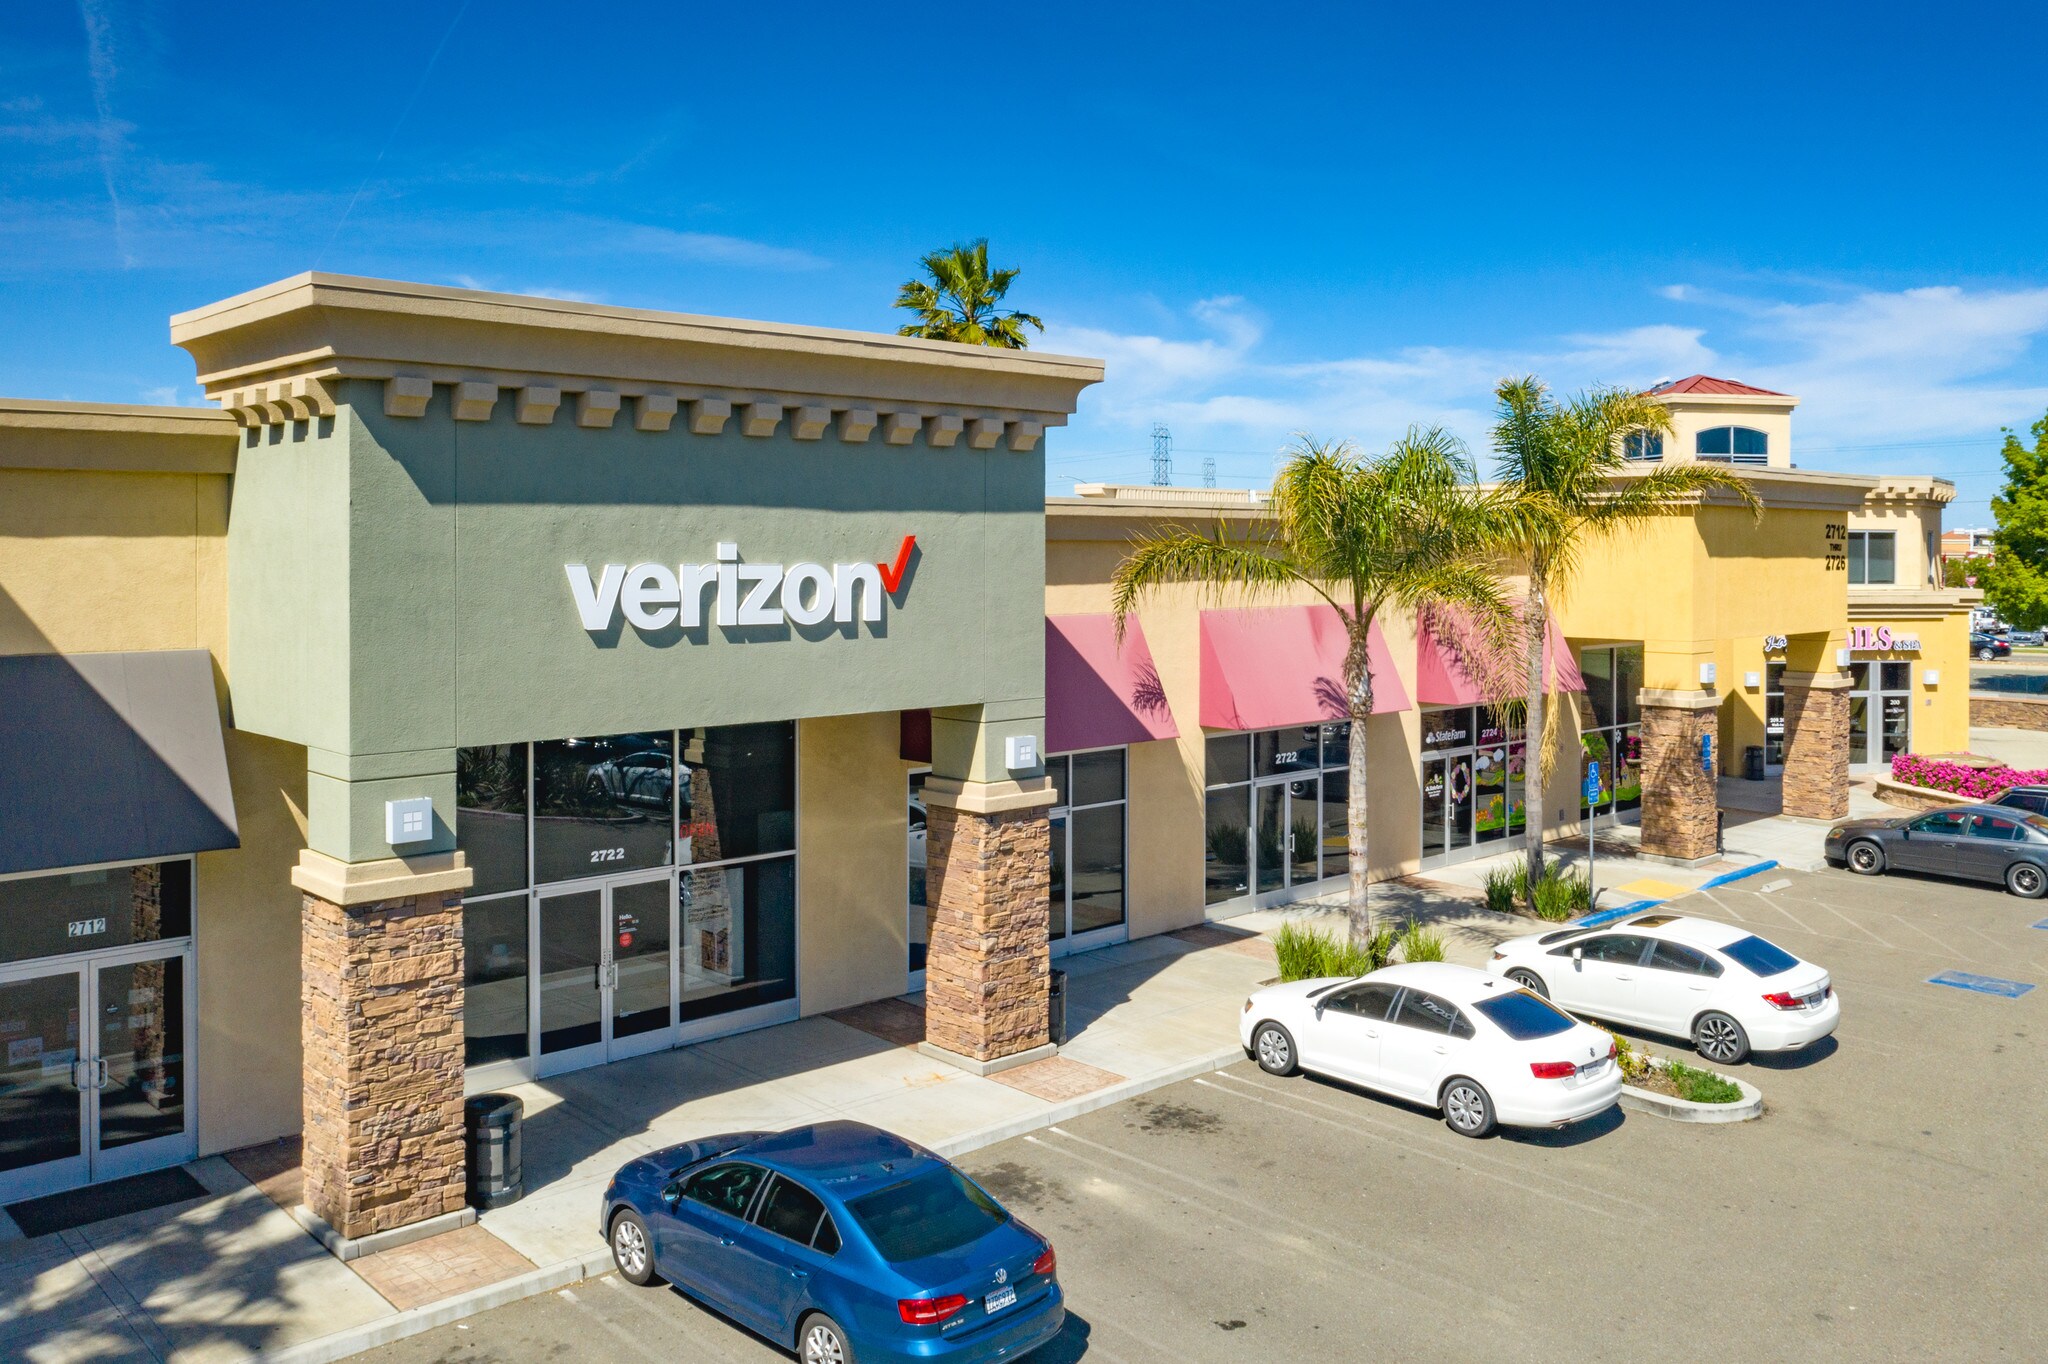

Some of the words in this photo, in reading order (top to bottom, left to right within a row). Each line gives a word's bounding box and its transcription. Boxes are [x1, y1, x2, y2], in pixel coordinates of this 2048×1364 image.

[1825, 524, 1846, 539] 2712
[1829, 543, 1842, 551] THRU
[1825, 555, 1846, 571] 2726
[564, 541, 882, 631] verizon
[1481, 728, 1498, 738] 2724
[1275, 751, 1298, 765] 2722
[590, 847, 625, 863] 2722
[70, 919, 104, 936] 2712
